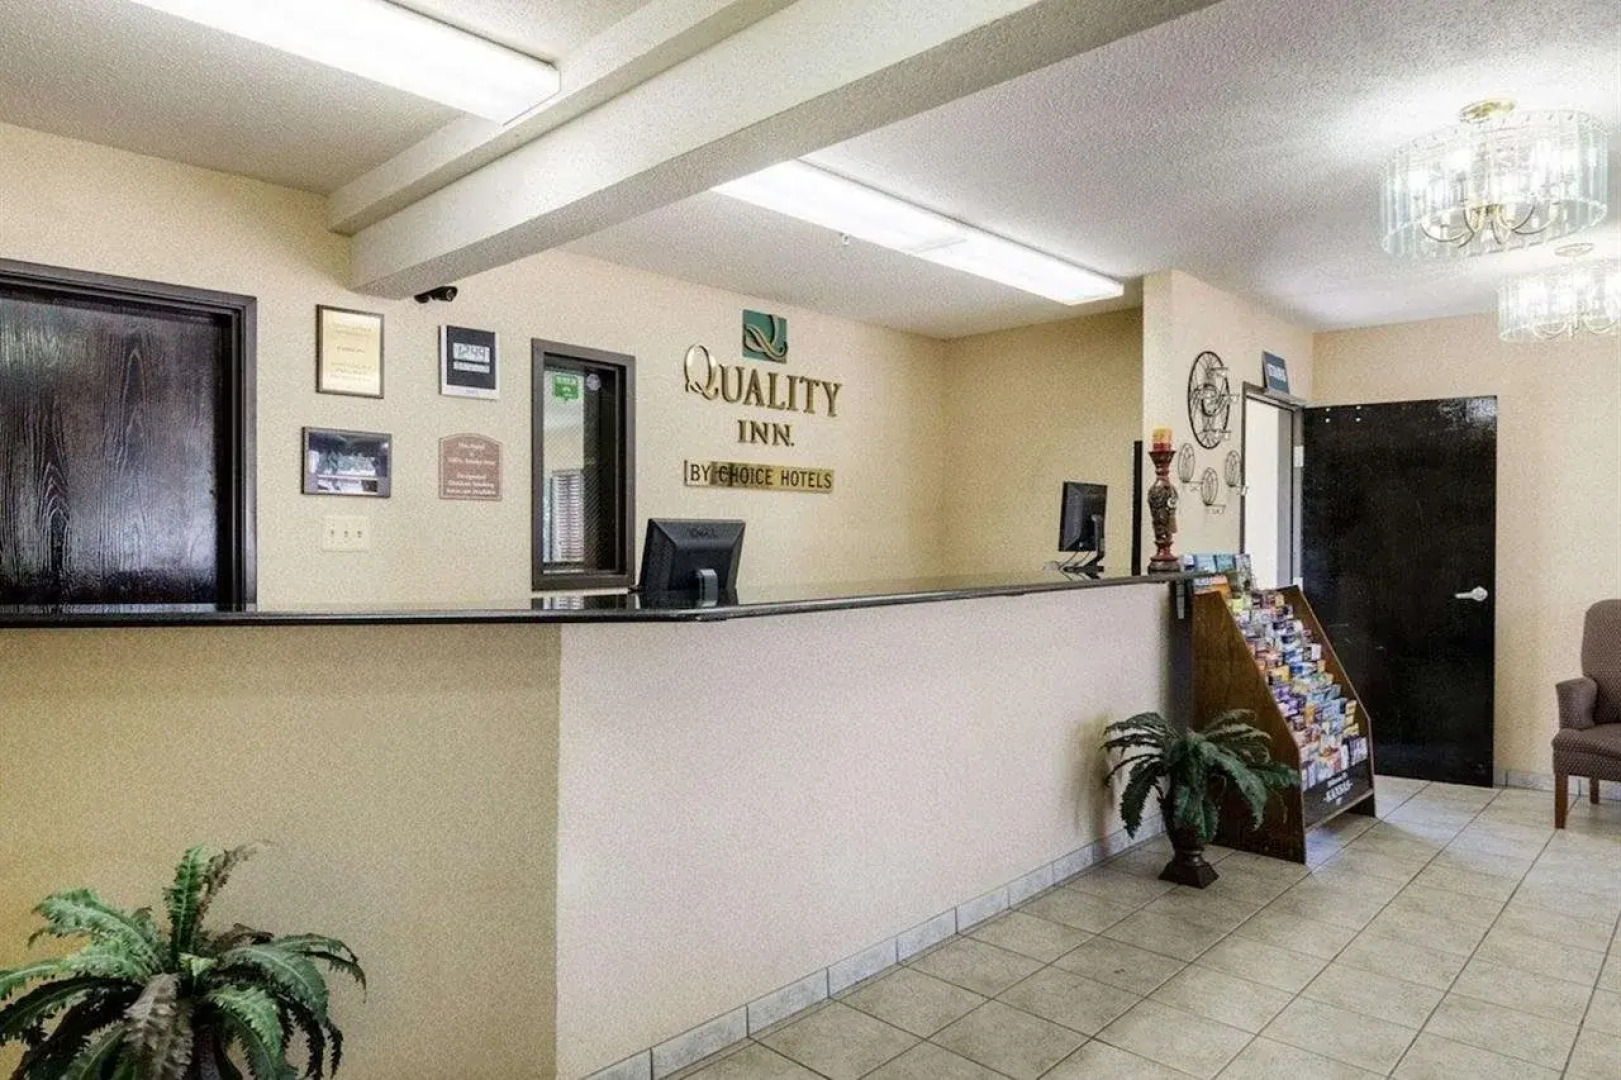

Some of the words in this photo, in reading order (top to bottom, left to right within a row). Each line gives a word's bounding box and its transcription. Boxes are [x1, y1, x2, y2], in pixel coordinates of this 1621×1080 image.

[684, 344, 842, 417] QUALITY
[690, 463, 711, 482] BY
[718, 465, 773, 485] CHOICE
[781, 469, 832, 489] HOTELS
